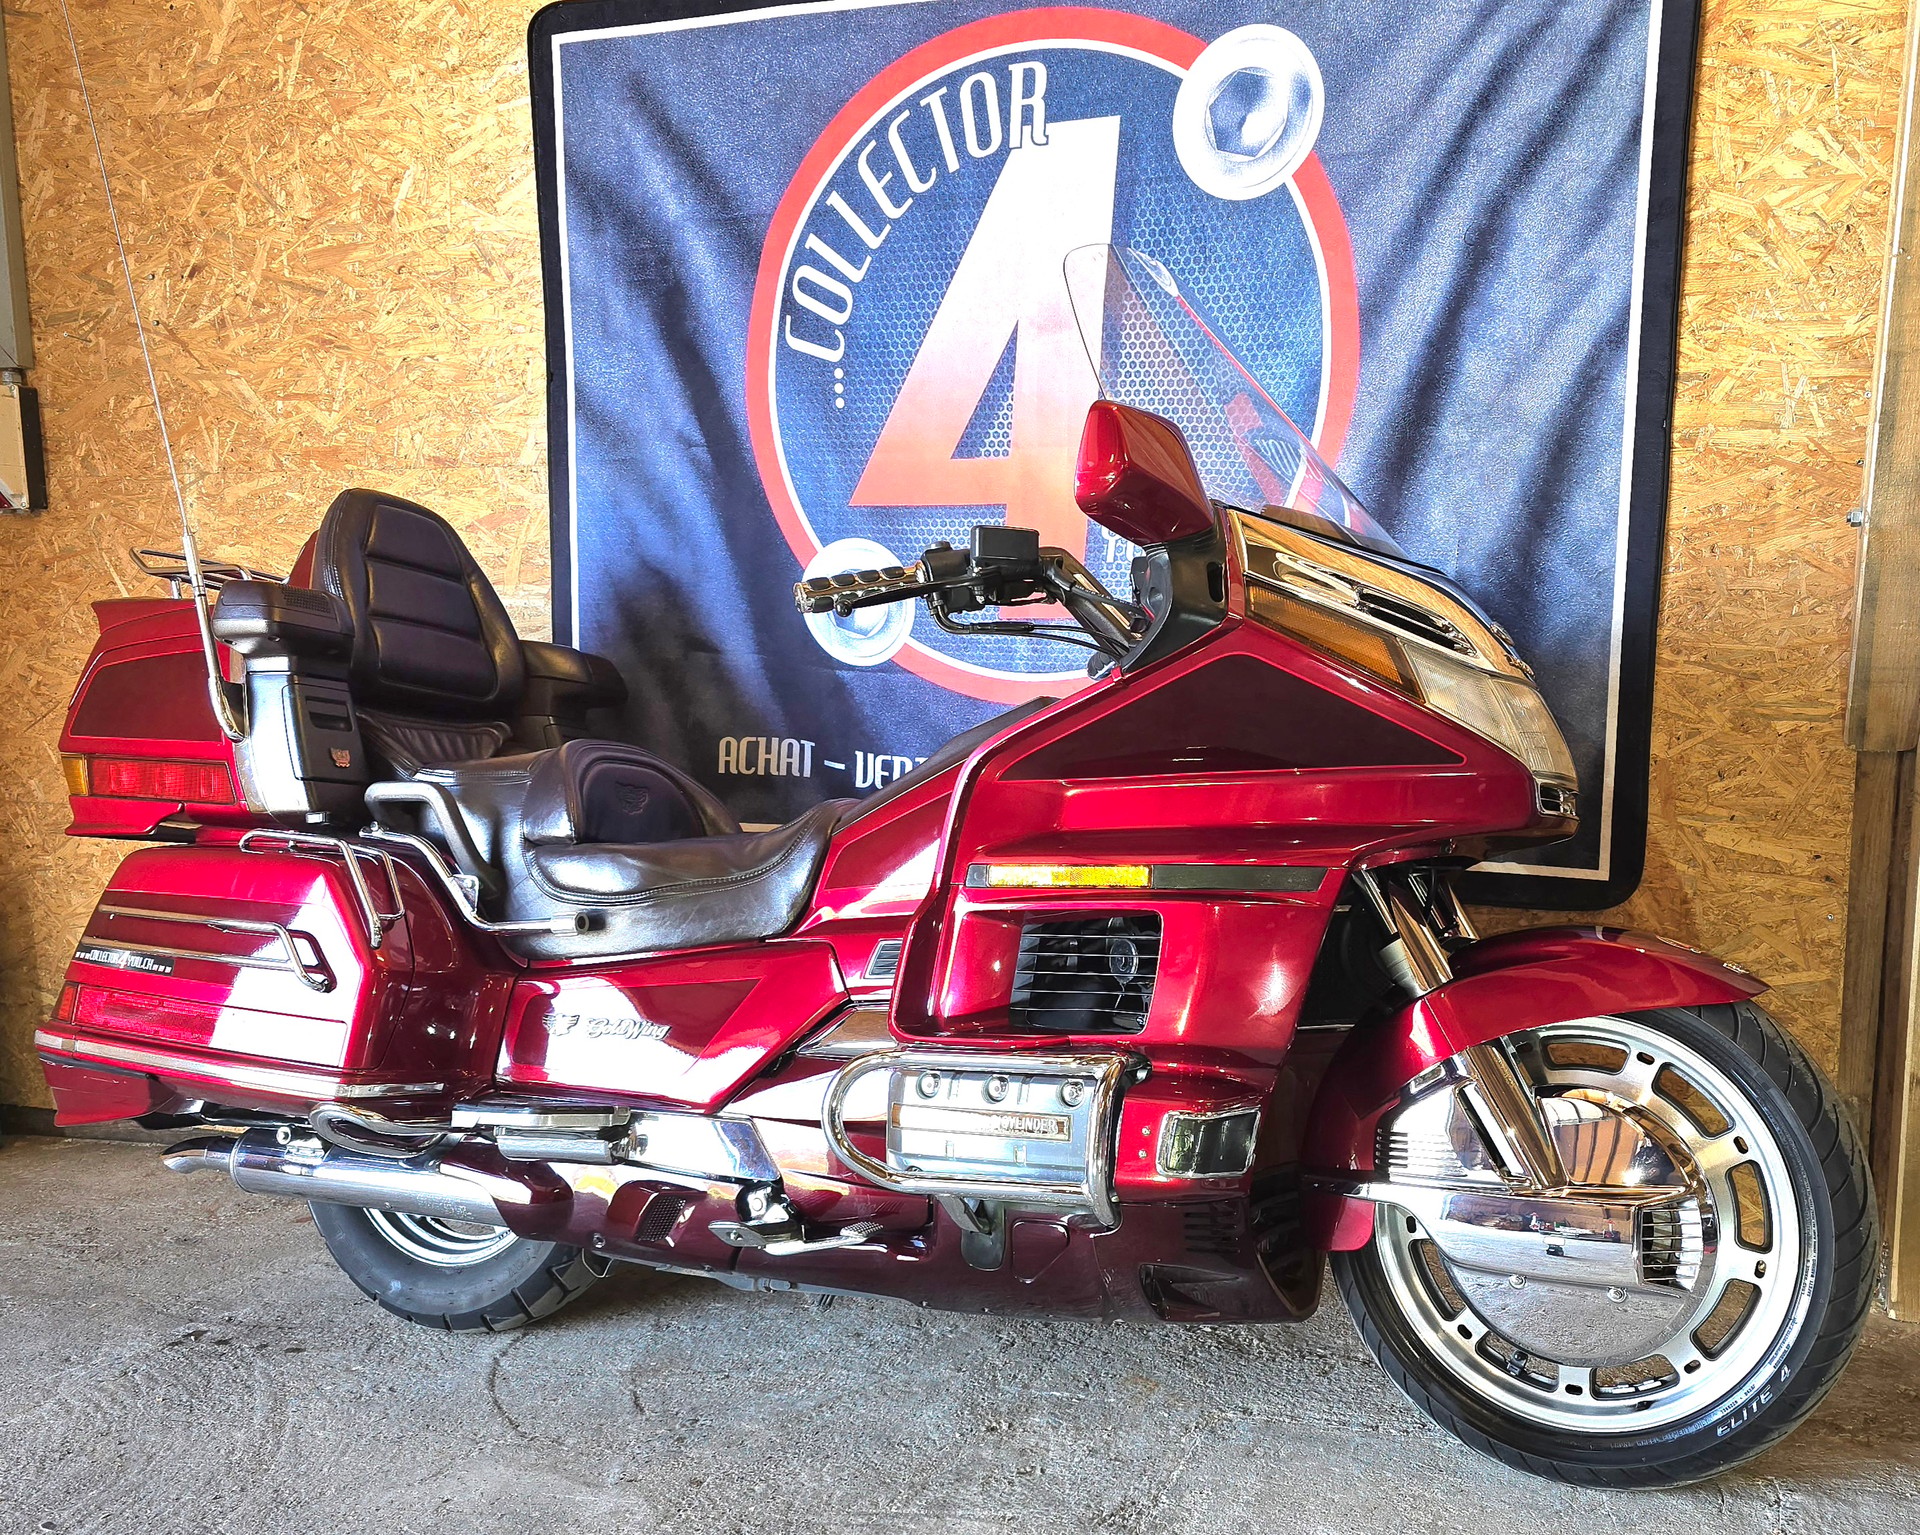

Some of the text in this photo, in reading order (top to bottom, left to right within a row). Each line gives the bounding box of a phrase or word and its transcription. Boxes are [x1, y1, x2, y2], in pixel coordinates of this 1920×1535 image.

[718, 736, 815, 778] ACHAT
[1716, 1384, 1773, 1437] ELITE
[1780, 1364, 1791, 1382] 4
